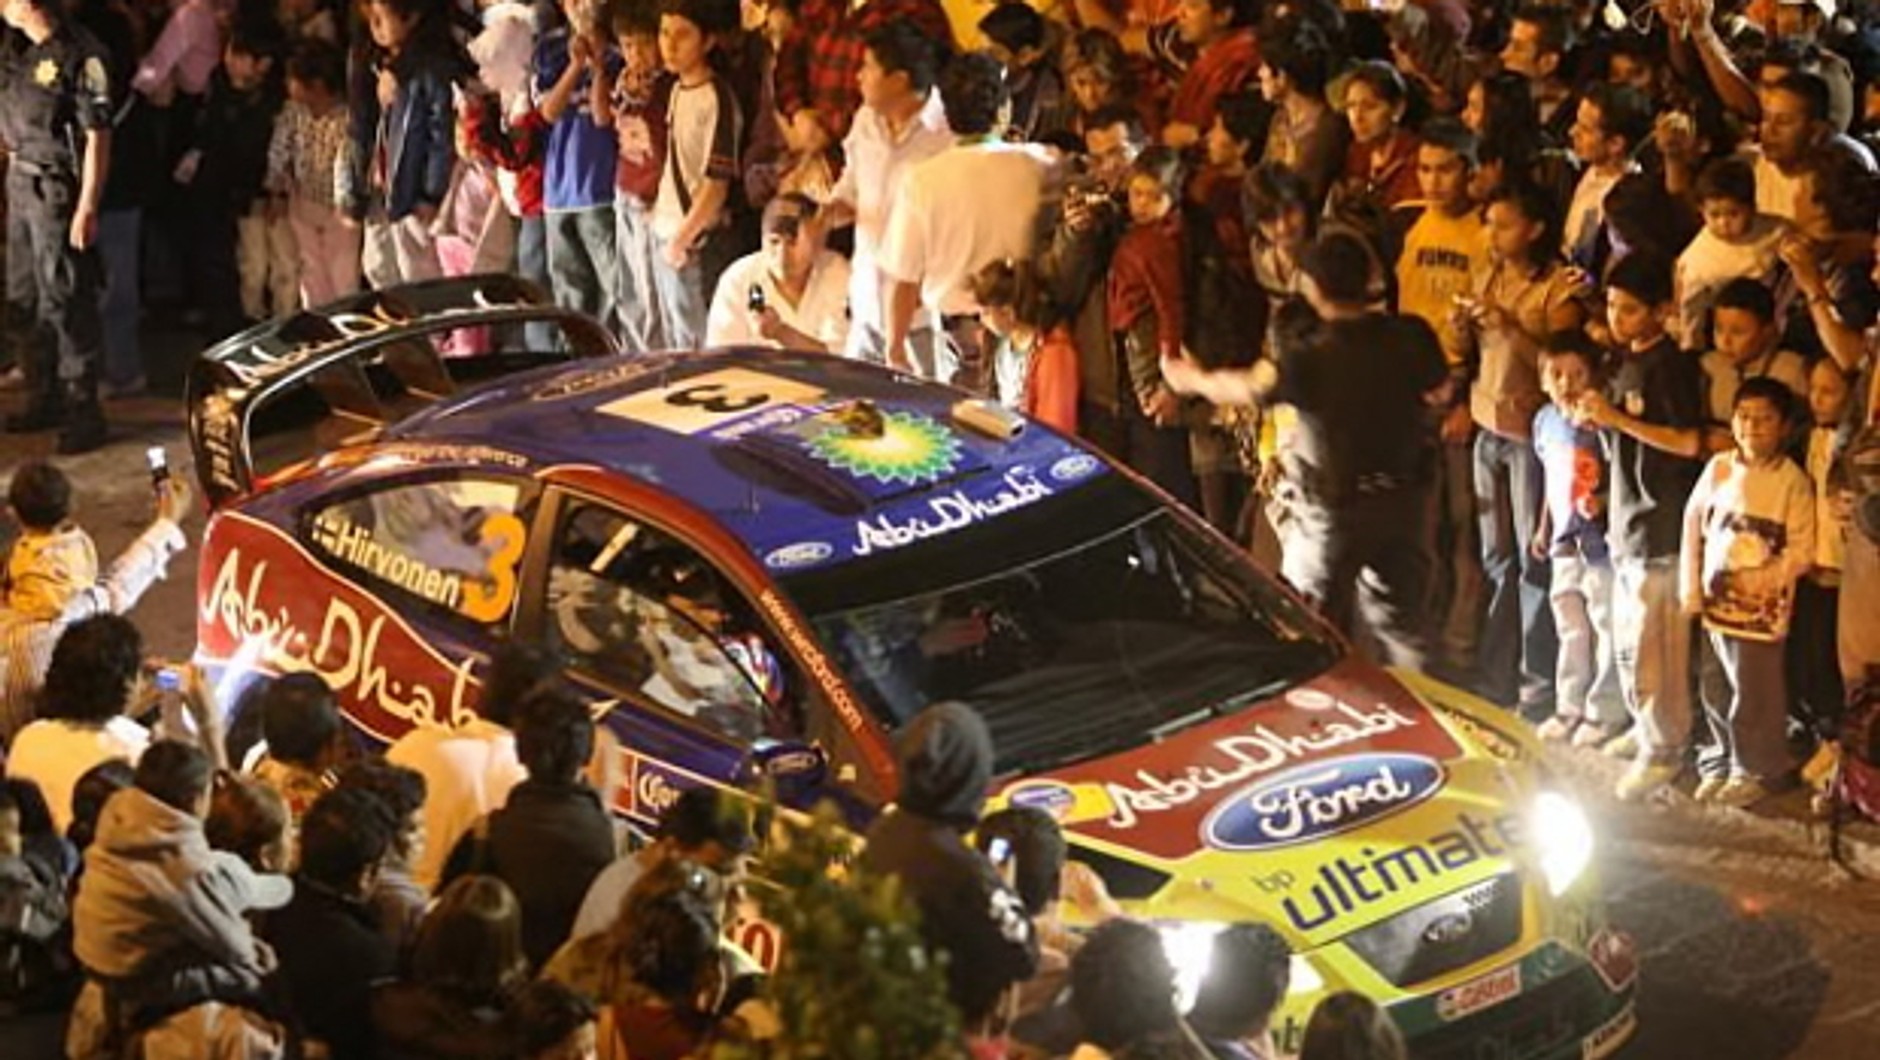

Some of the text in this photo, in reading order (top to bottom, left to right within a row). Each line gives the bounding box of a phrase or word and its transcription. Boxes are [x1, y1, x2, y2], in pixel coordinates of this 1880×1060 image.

[665, 384, 770, 413] 3
[334, 520, 460, 608] Hirvonen
[457, 512, 525, 624] 3
[1252, 765, 1411, 840] Ford
[1250, 867, 1296, 895] bp
